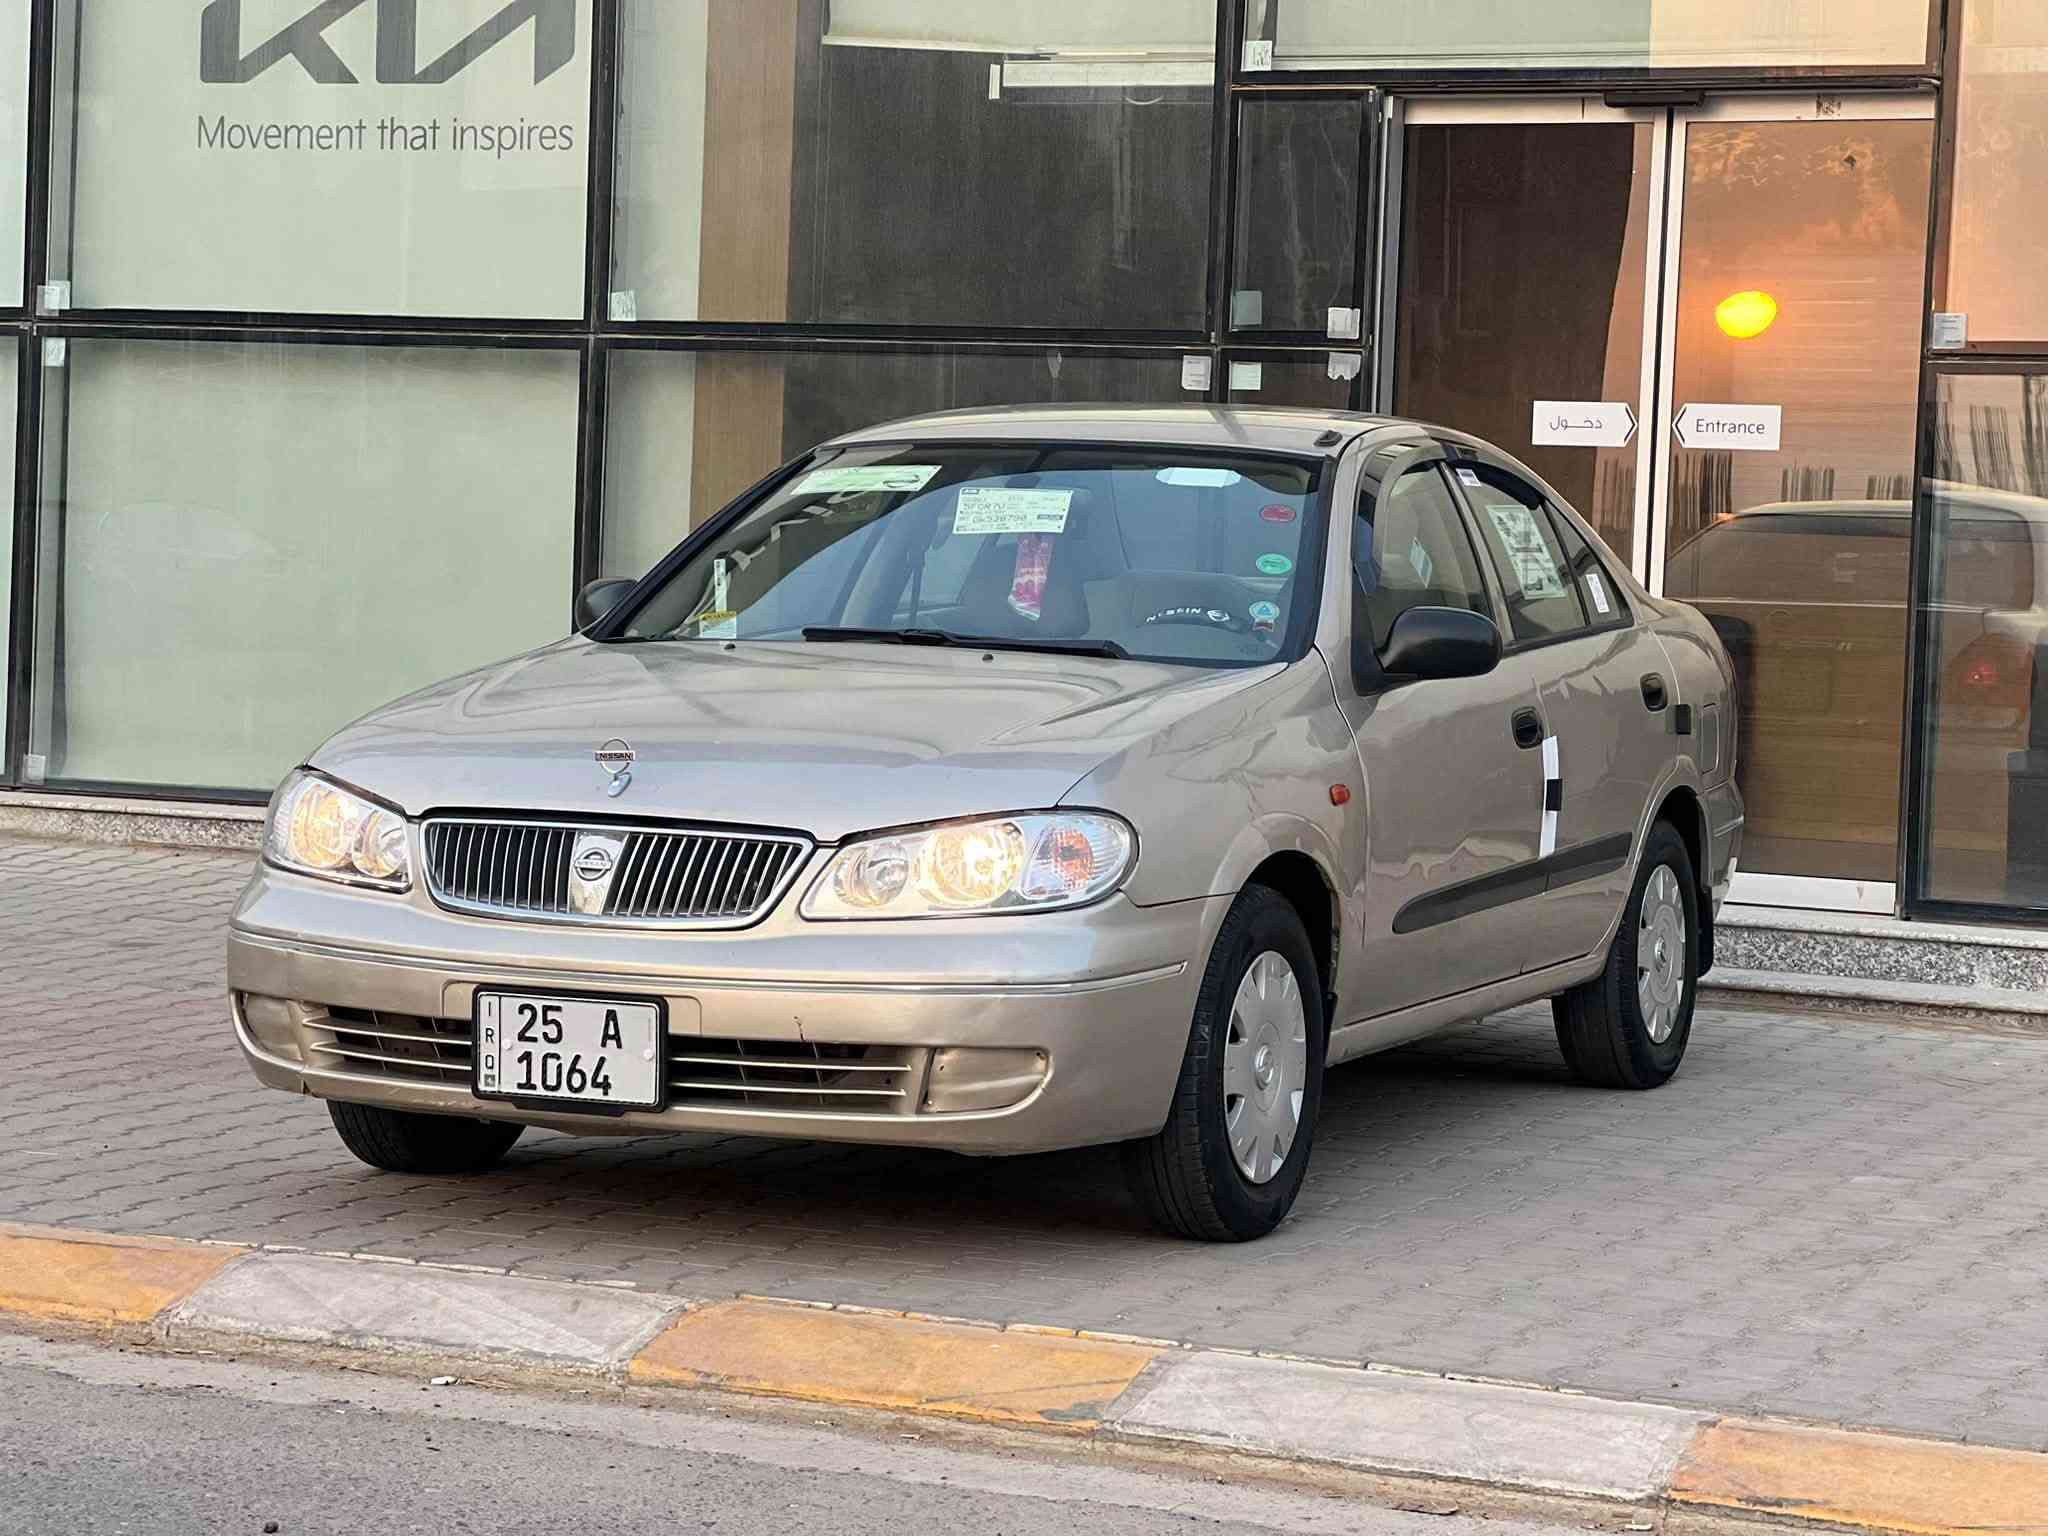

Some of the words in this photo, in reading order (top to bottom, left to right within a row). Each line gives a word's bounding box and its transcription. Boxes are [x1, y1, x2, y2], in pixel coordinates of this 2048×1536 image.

[197, 115, 367, 151] Movement
[377, 116, 441, 151] that
[452, 117, 574, 159] inspires
[1695, 418, 1765, 434] Entrance
[599, 752, 633, 761] NISSAN
[517, 1003, 563, 1044] 25
[600, 1008, 622, 1049] A
[516, 1050, 612, 1096] 1064
